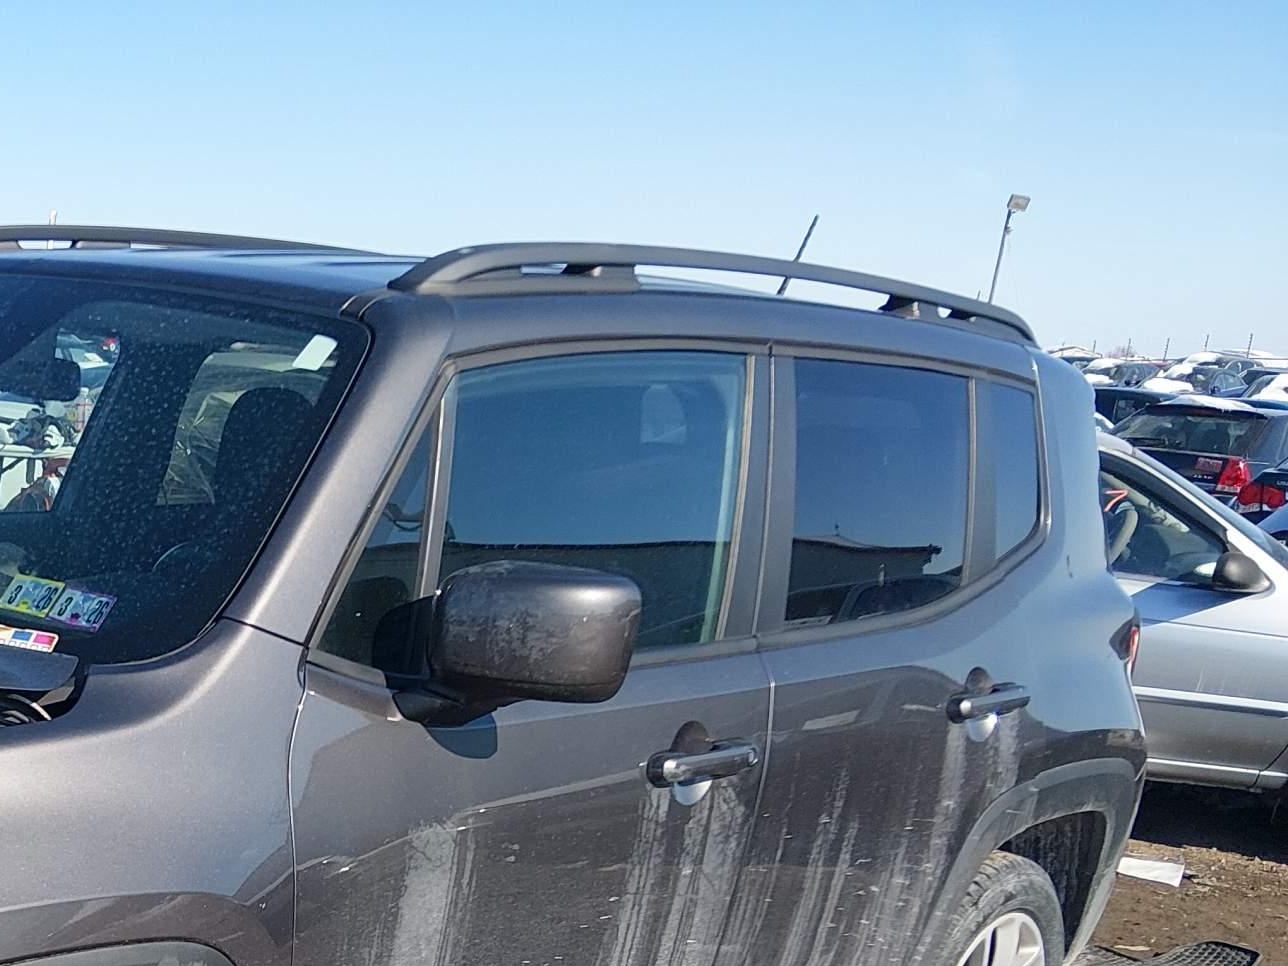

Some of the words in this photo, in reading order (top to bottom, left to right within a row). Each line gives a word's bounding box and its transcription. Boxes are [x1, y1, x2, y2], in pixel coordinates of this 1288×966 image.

[7, 584, 23, 605] 3
[35, 586, 59, 610] 26
[57, 596, 73, 617] 3
[85, 599, 109, 624] 26
